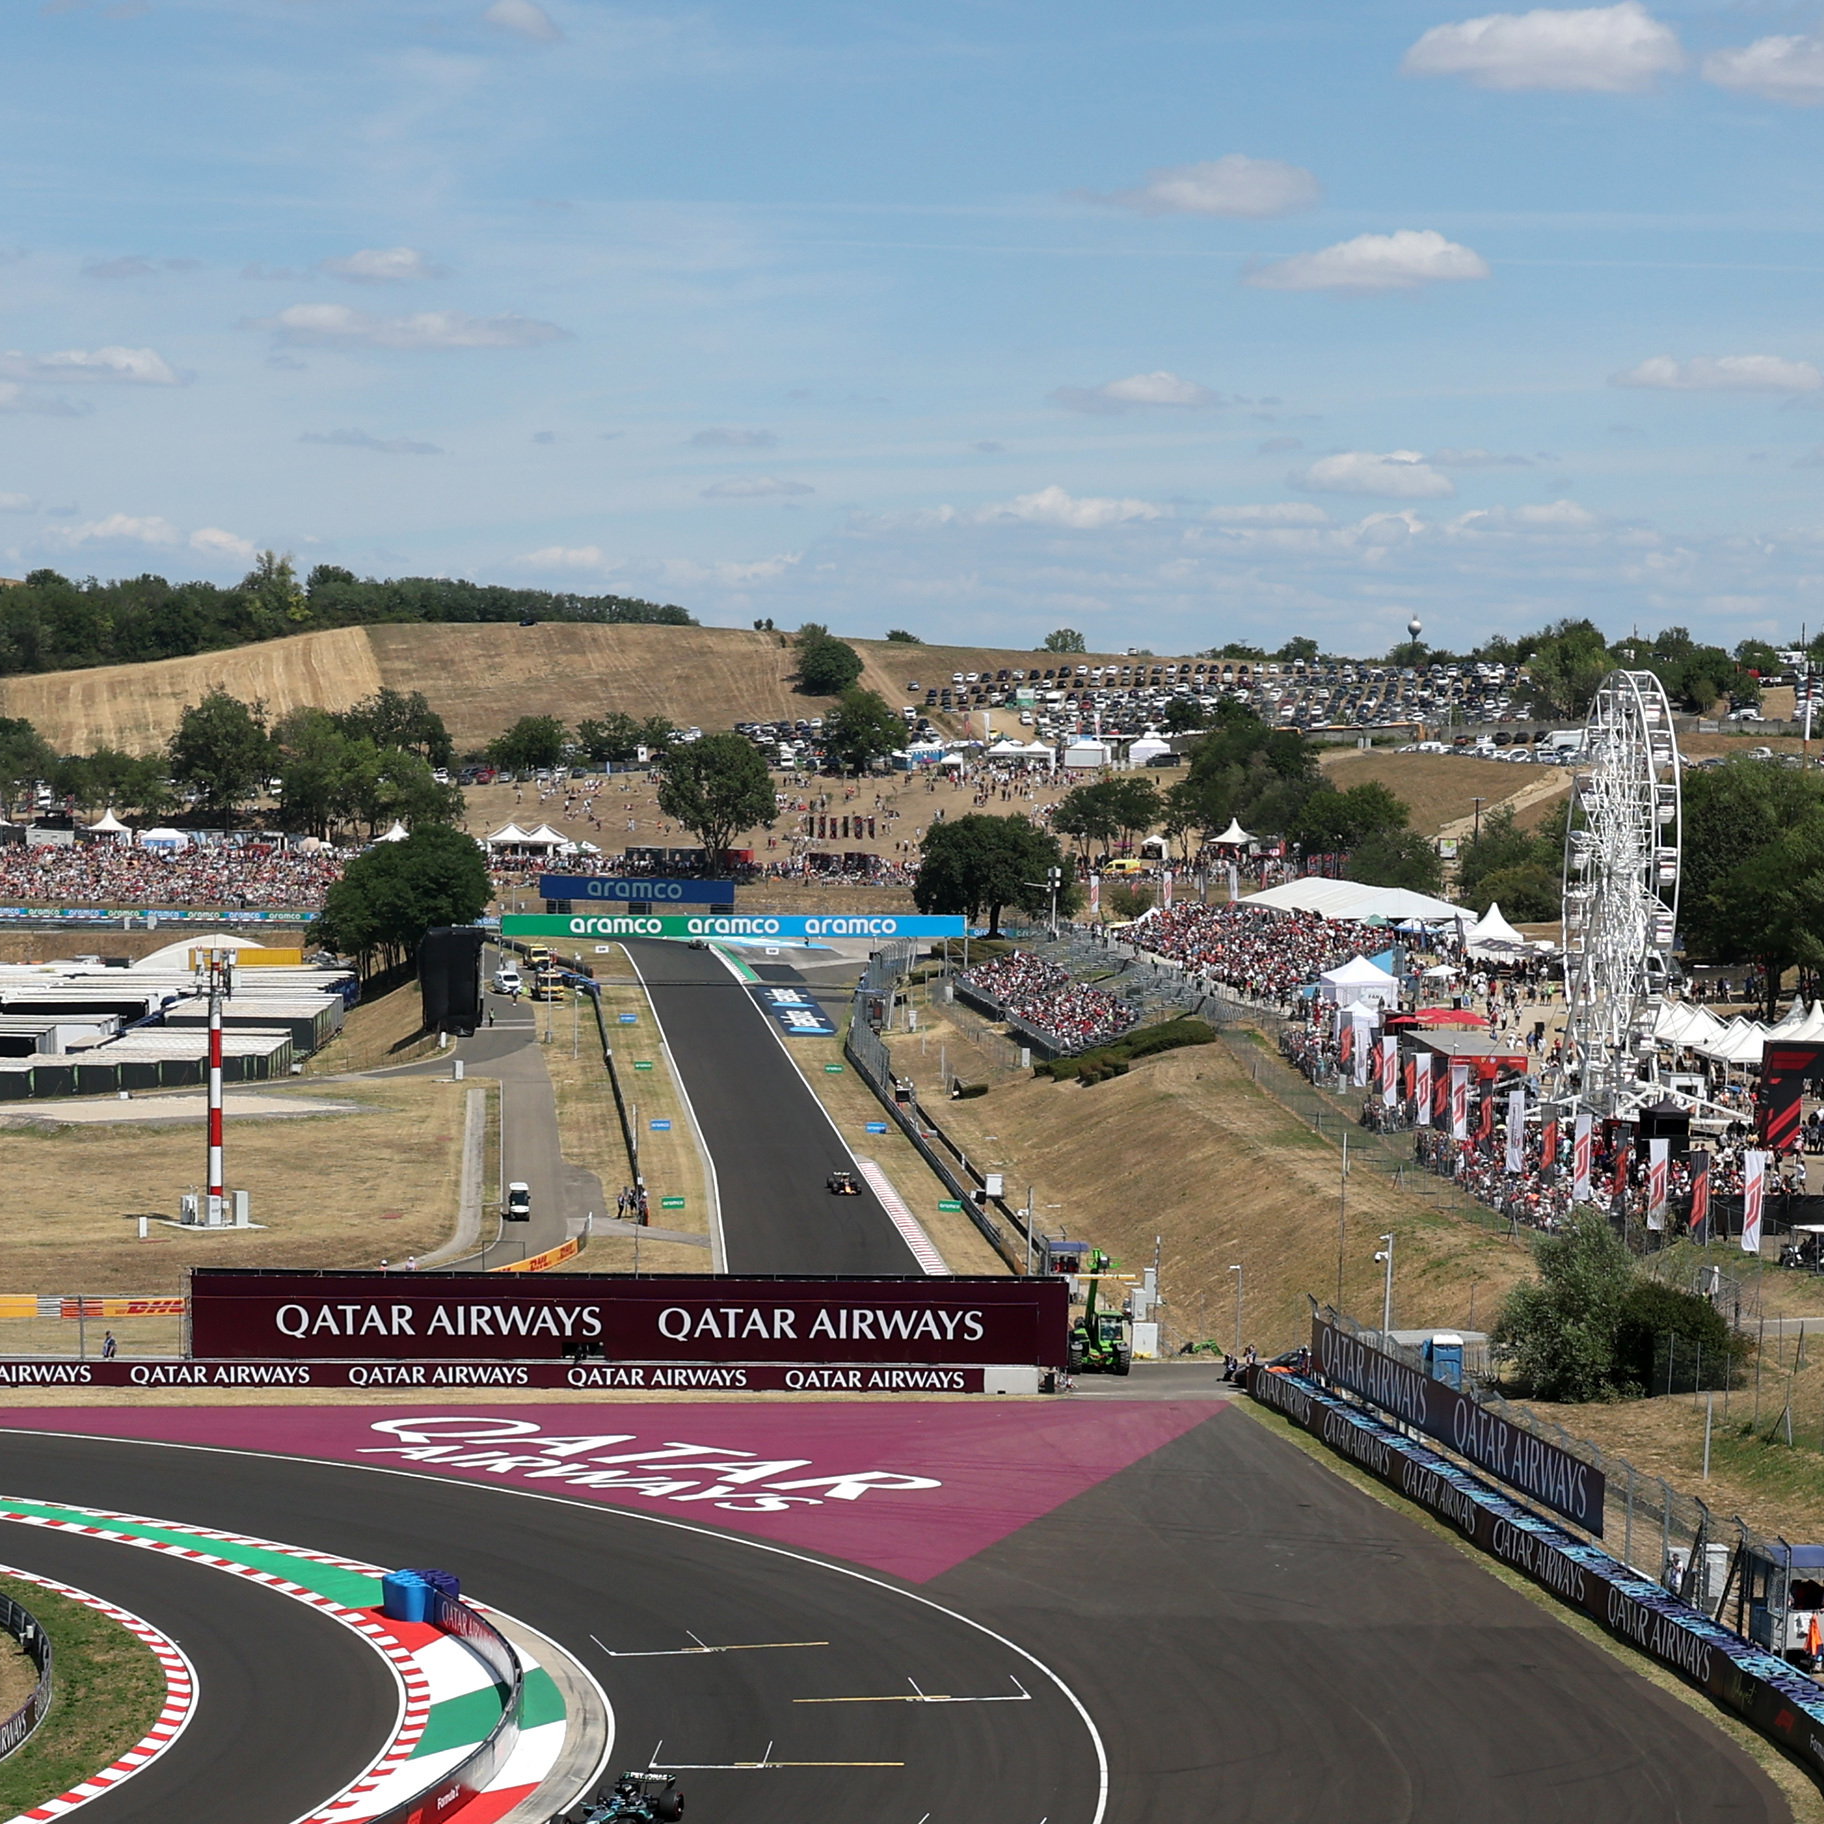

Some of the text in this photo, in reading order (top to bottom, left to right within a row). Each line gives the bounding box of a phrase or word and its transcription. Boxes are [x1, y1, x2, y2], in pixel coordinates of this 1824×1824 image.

[587, 880, 682, 900] aramco
[28, 908, 60, 916] aramco
[569, 918, 662, 934] aramco
[688, 918, 780, 934] aramco
[805, 918, 897, 934] aramco
[276, 1304, 601, 1341] QATAR AIRWAYS
[658, 1308, 984, 1341] QATAR AIRWAYS
[1321, 1327, 1426, 1426] QATAR AIRWAYS
[371, 1416, 942, 1500] QATAR
[1454, 1398, 1587, 1519] QATAR AIRWAYS
[355, 1445, 824, 1512] AIRWAYS
[1492, 1519, 1585, 1602] QATAR AIRWAYS
[1607, 1586, 1712, 1683] QATAR AIRWAYS
